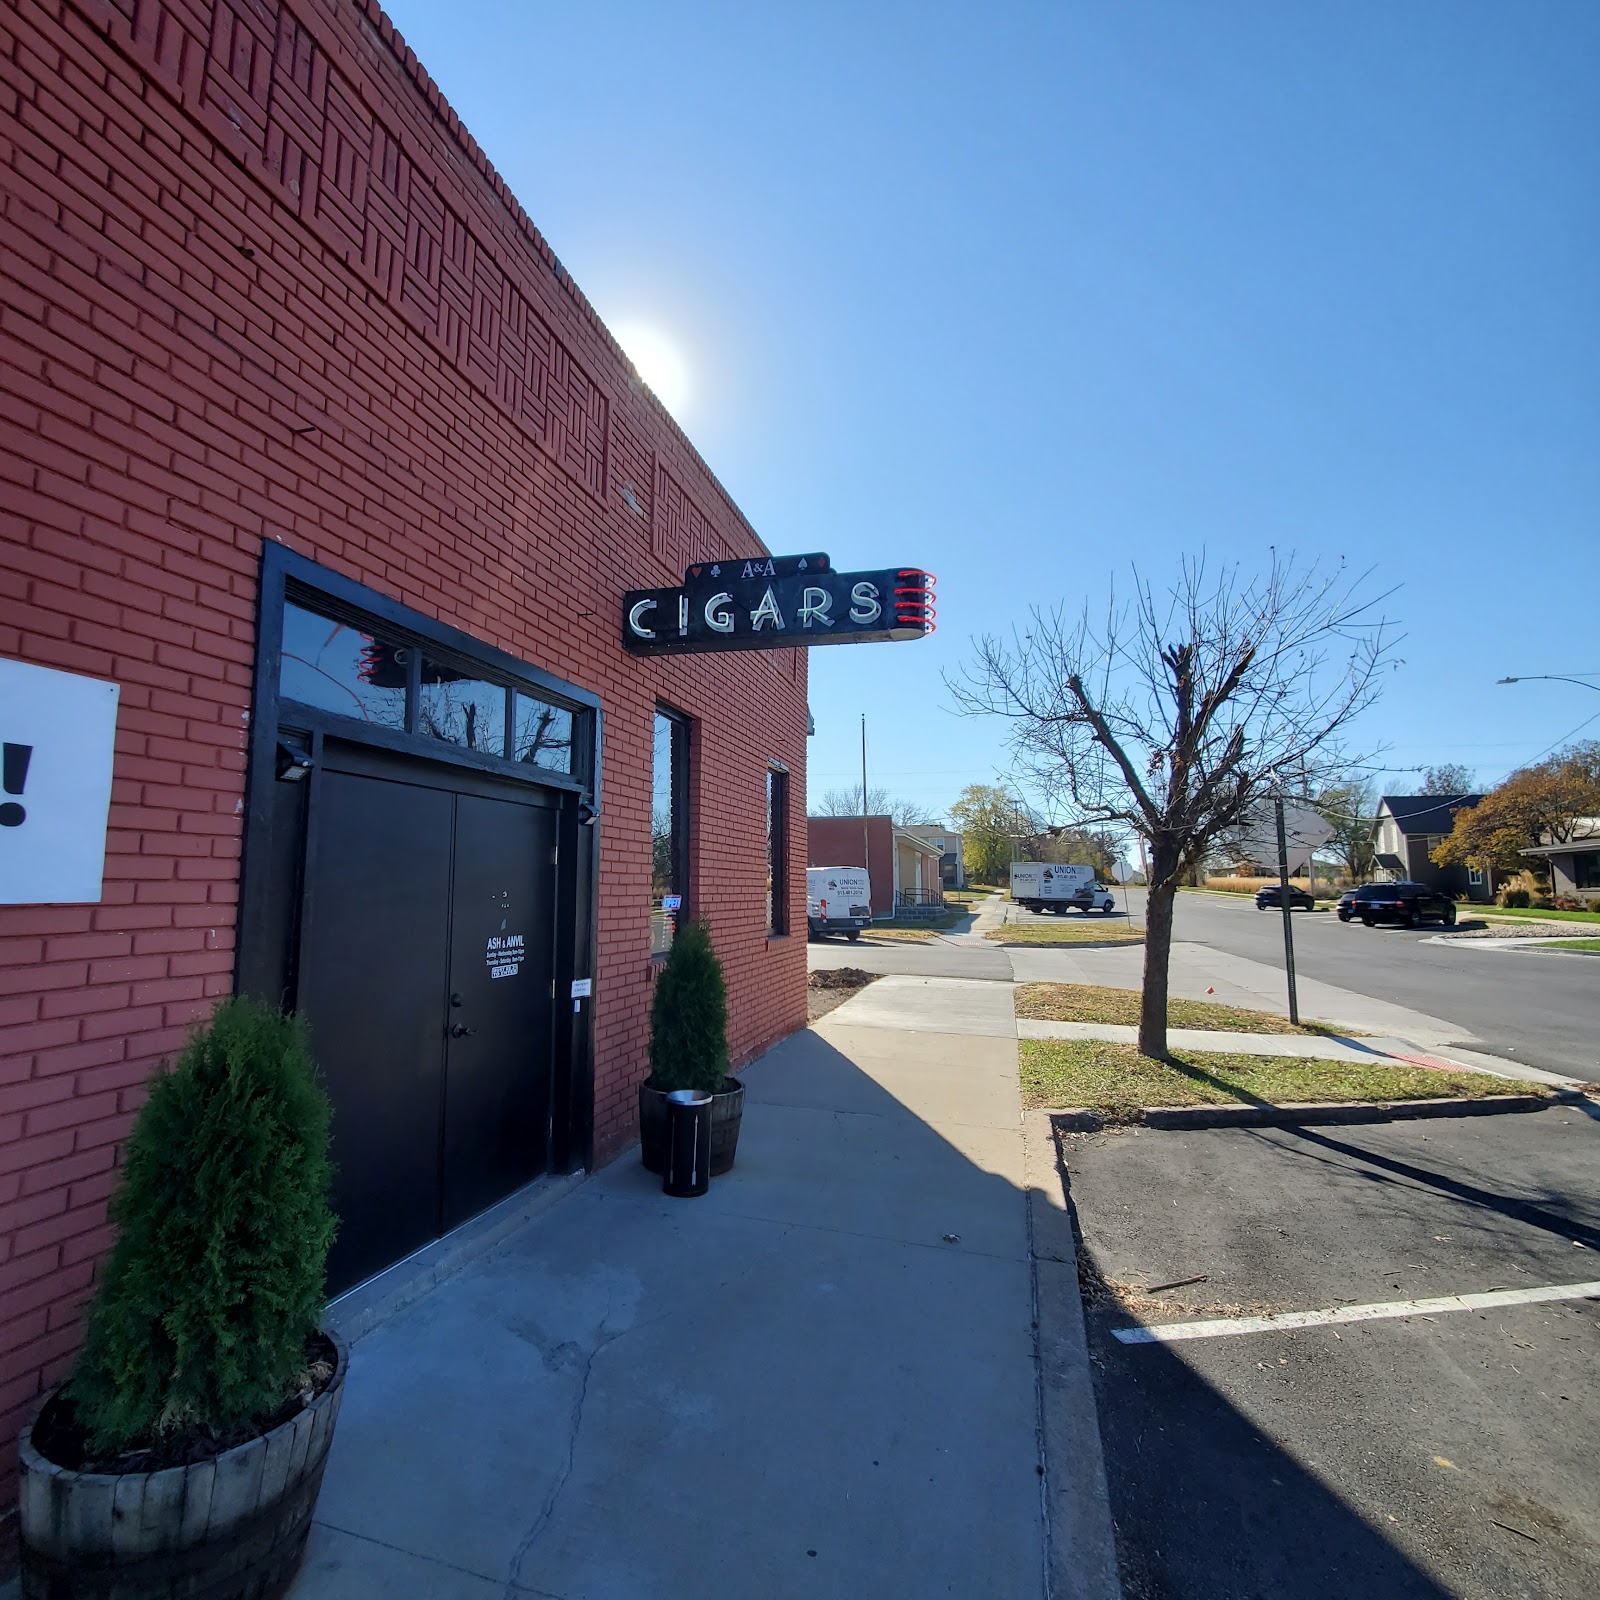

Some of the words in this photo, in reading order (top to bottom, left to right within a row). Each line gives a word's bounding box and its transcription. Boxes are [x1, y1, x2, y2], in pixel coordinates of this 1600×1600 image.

[741, 559, 776, 578] A&A
[629, 581, 882, 639] CIGARS
[1054, 865, 1076, 874] UNION
[487, 937, 502, 950] ASH
[506, 935, 525, 948] ANVIL
